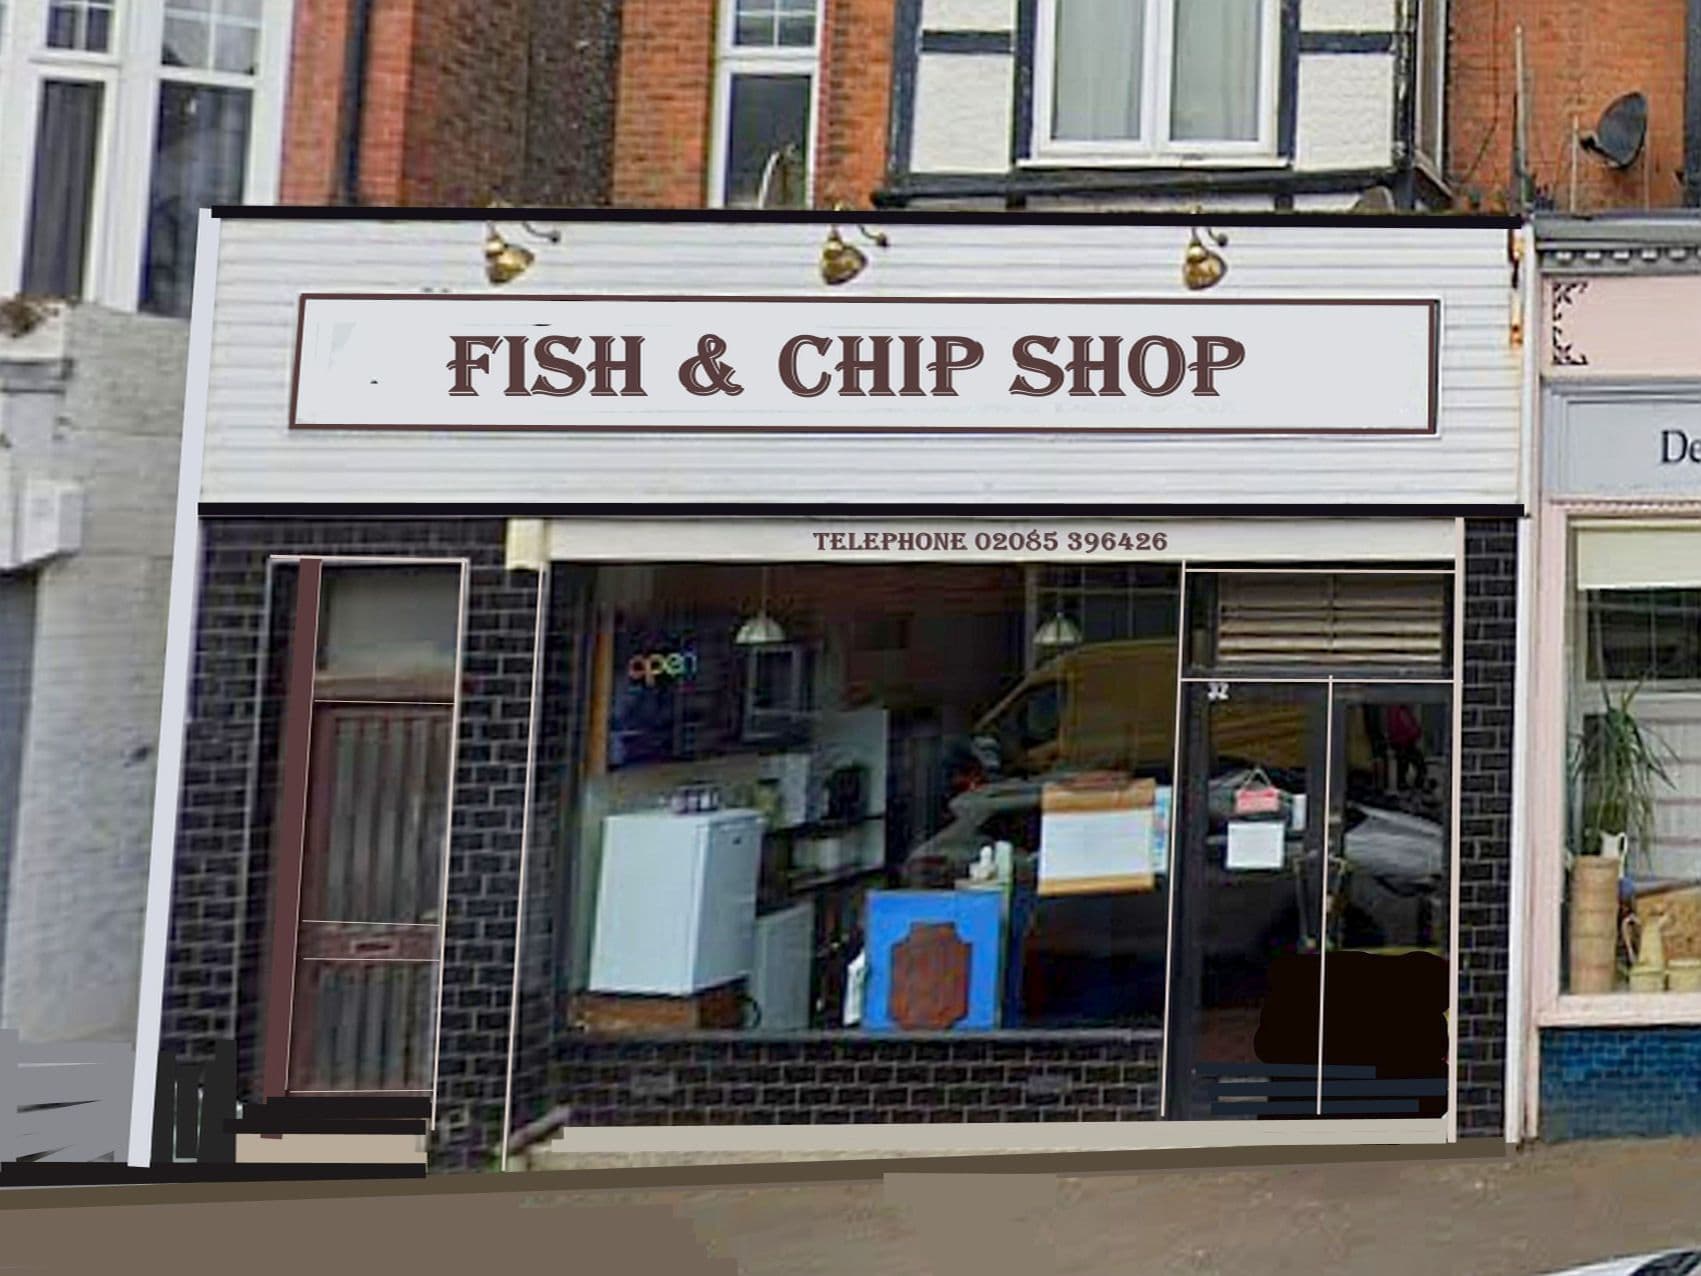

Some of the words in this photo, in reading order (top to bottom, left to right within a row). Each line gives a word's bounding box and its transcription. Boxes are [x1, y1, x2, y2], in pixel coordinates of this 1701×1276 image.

[446, 334, 649, 398] FISH
[679, 333, 745, 397] &
[778, 334, 985, 398] CHIP
[1008, 334, 1246, 398] SHOP
[812, 531, 969, 551] TELEPHONE
[974, 528, 1059, 551] 02085
[1066, 531, 1169, 554] 396426
